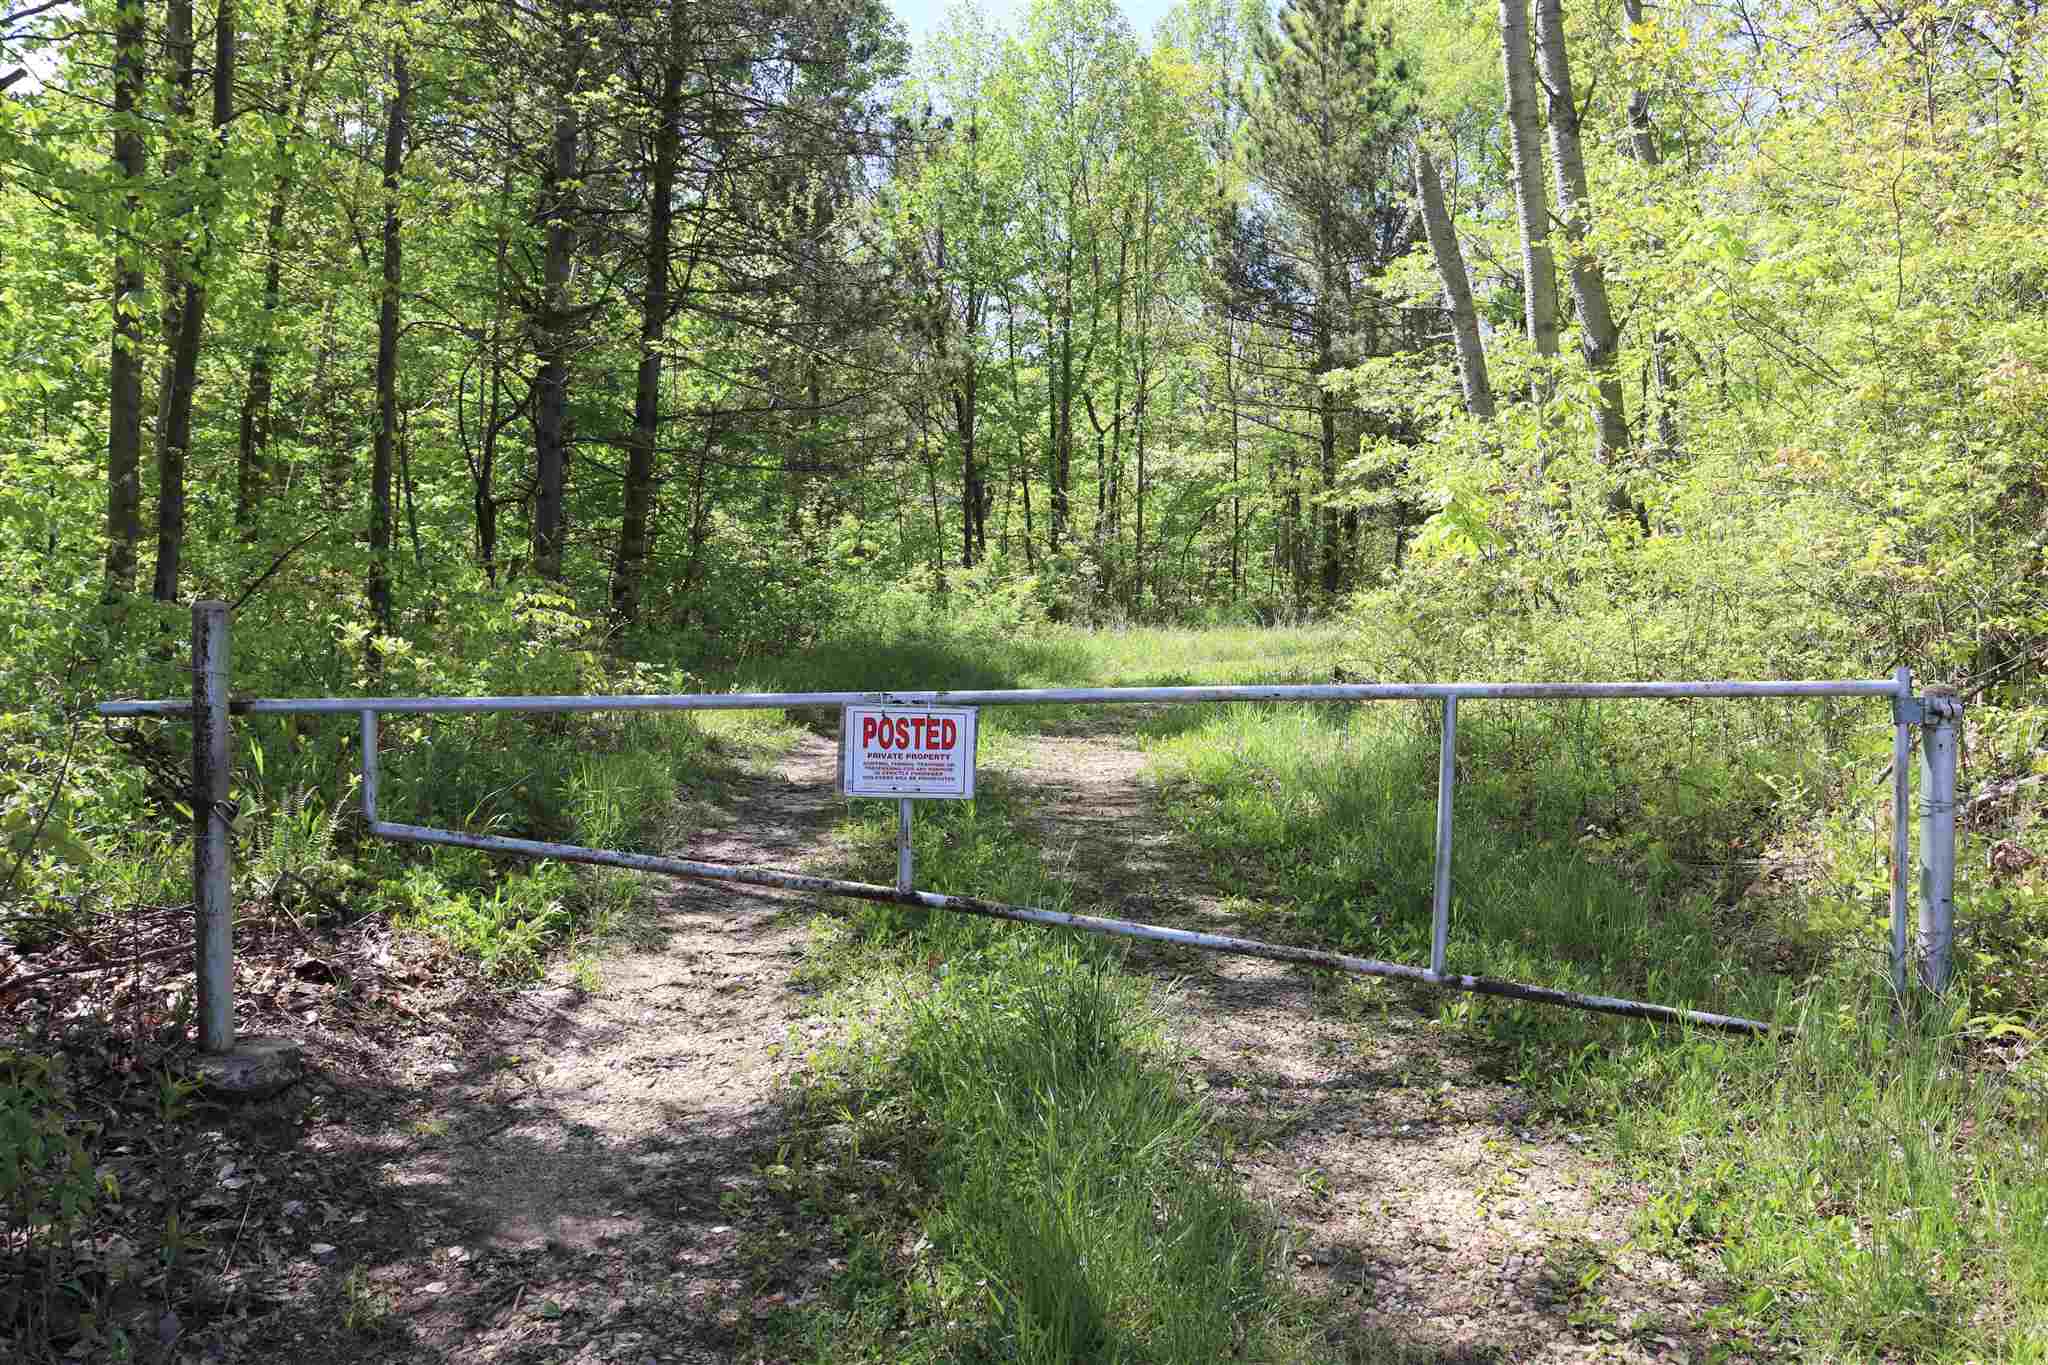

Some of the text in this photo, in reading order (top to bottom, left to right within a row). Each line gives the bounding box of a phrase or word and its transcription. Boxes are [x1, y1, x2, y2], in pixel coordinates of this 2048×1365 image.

[863, 717, 957, 750] POSTED
[867, 752, 951, 761] PRIVATE PROPERTY
